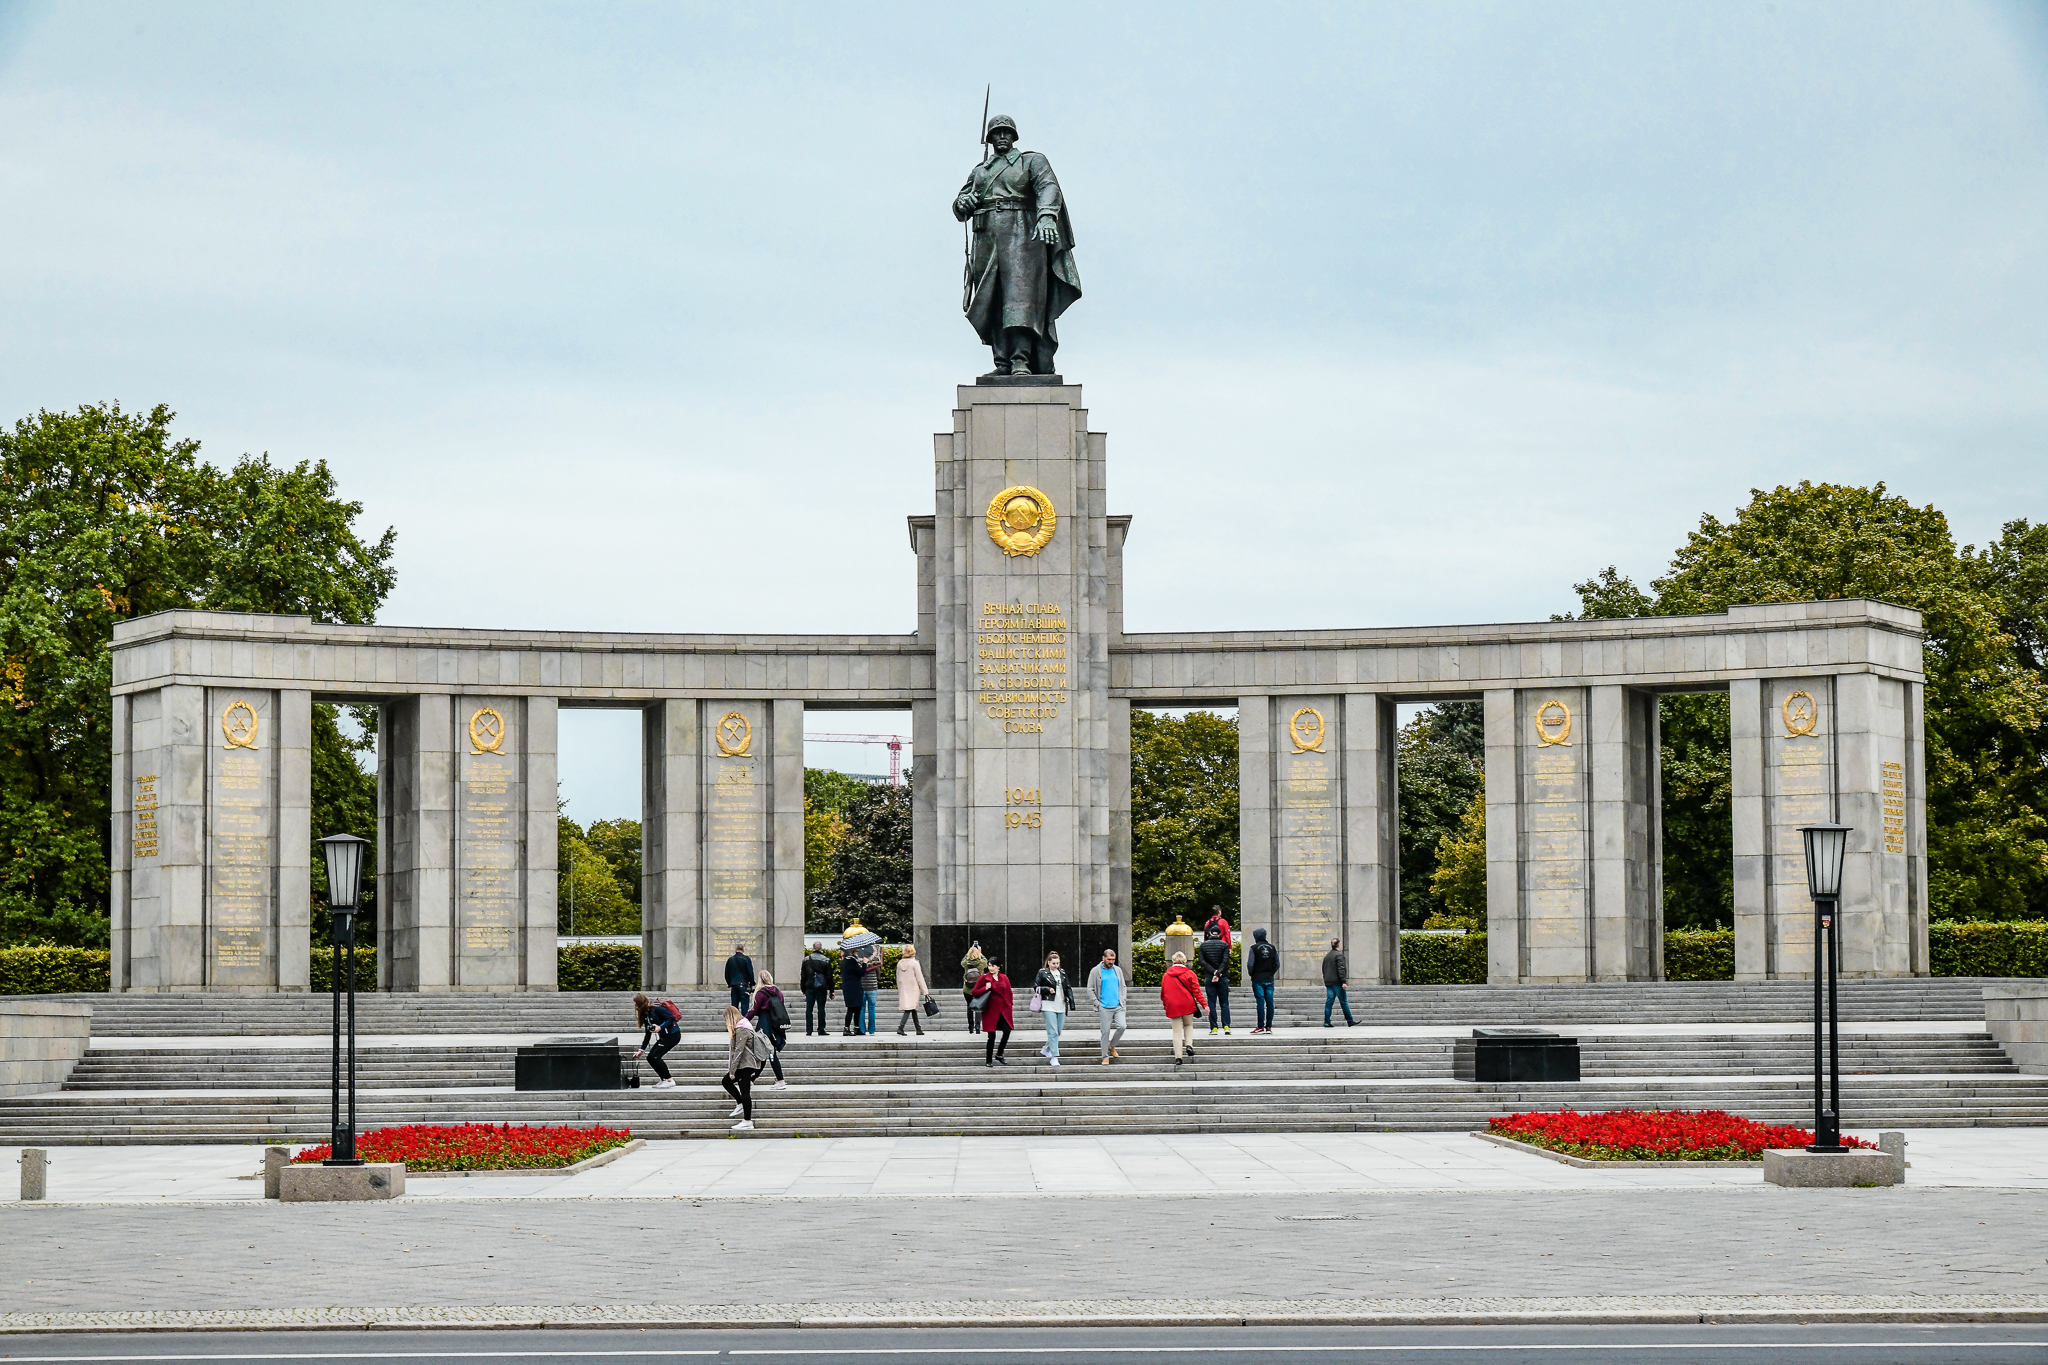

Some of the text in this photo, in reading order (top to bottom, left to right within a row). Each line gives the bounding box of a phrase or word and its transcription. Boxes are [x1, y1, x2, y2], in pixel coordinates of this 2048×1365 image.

[983, 602, 1061, 615] ВЕЧНАЯ СЛАВА
[978, 618, 1066, 629] ГЕРОЯМ ПАВШИМ
[978, 633, 1066, 645] В БОЯХ С НЕМЕЦКО
[978, 648, 1066, 659] ФАШИСТСКИМИ
[978, 663, 1066, 674] ЗАХВАТЧИКАМИ
[980, 678, 1067, 689] ЗА СВОБОДУ И
[978, 692, 1067, 704] НЕЗАВИСИМОСТЬ
[987, 705, 1058, 719] СОВЕТСКОГО
[1003, 721, 1044, 734] СОЮЗА
[1005, 787, 1042, 805] 1941
[1004, 811, 1043, 829] 1945
